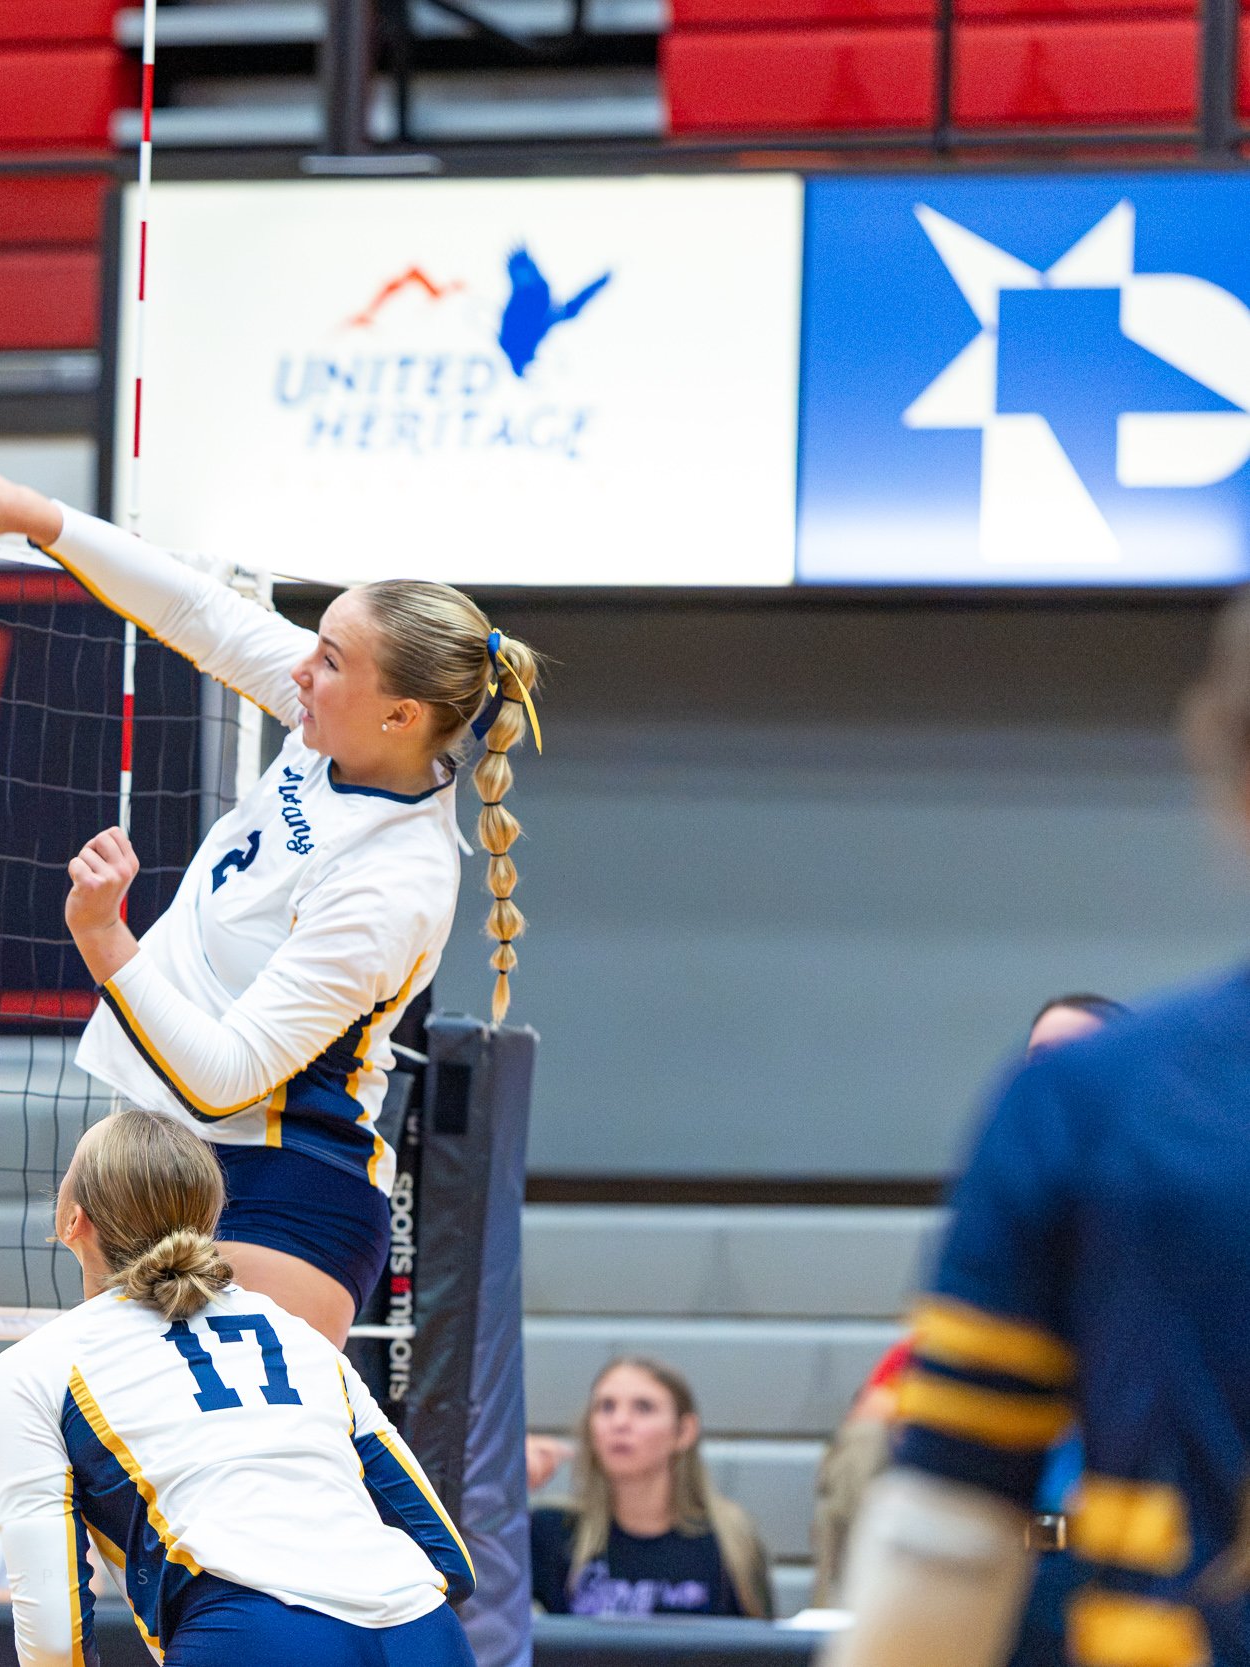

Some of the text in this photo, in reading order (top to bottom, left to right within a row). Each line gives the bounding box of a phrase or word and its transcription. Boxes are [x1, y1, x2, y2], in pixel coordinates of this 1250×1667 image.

[271, 352, 500, 407] UNITED
[304, 402, 597, 461] HERITAGE
[211, 829, 263, 895] 2
[160, 1314, 303, 1412] 17
